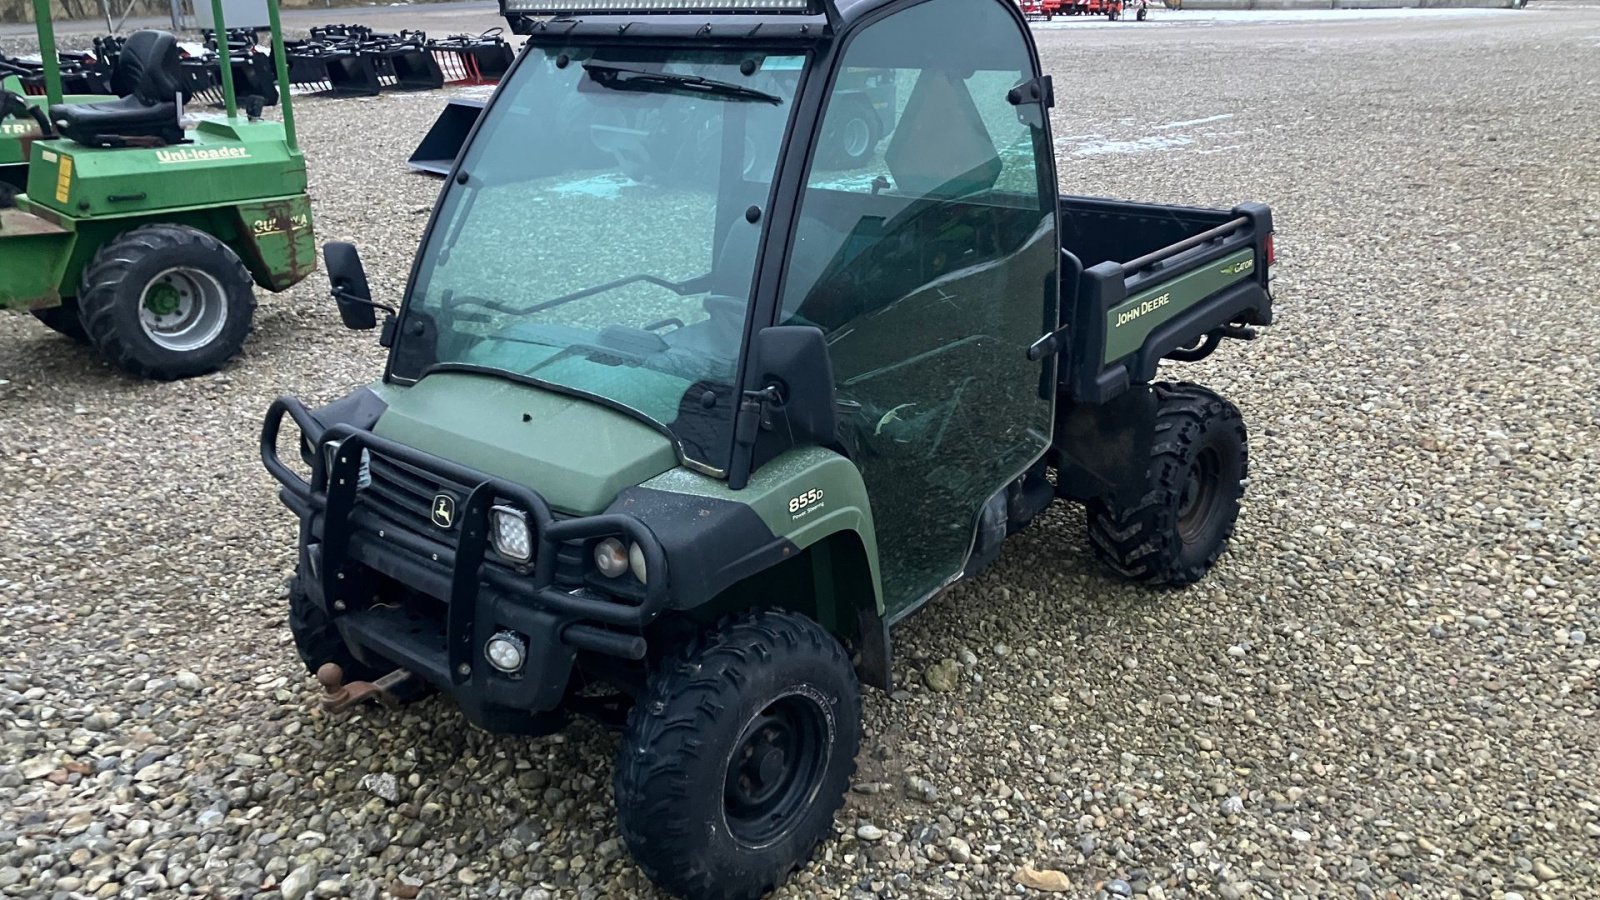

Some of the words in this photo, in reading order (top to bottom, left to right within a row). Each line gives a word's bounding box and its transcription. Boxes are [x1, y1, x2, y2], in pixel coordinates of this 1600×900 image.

[155, 146, 247, 163] Uni-loader
[1115, 306, 1140, 328] JOHN
[1141, 292, 1170, 316] DEERE
[788, 488, 824, 513] 855D
